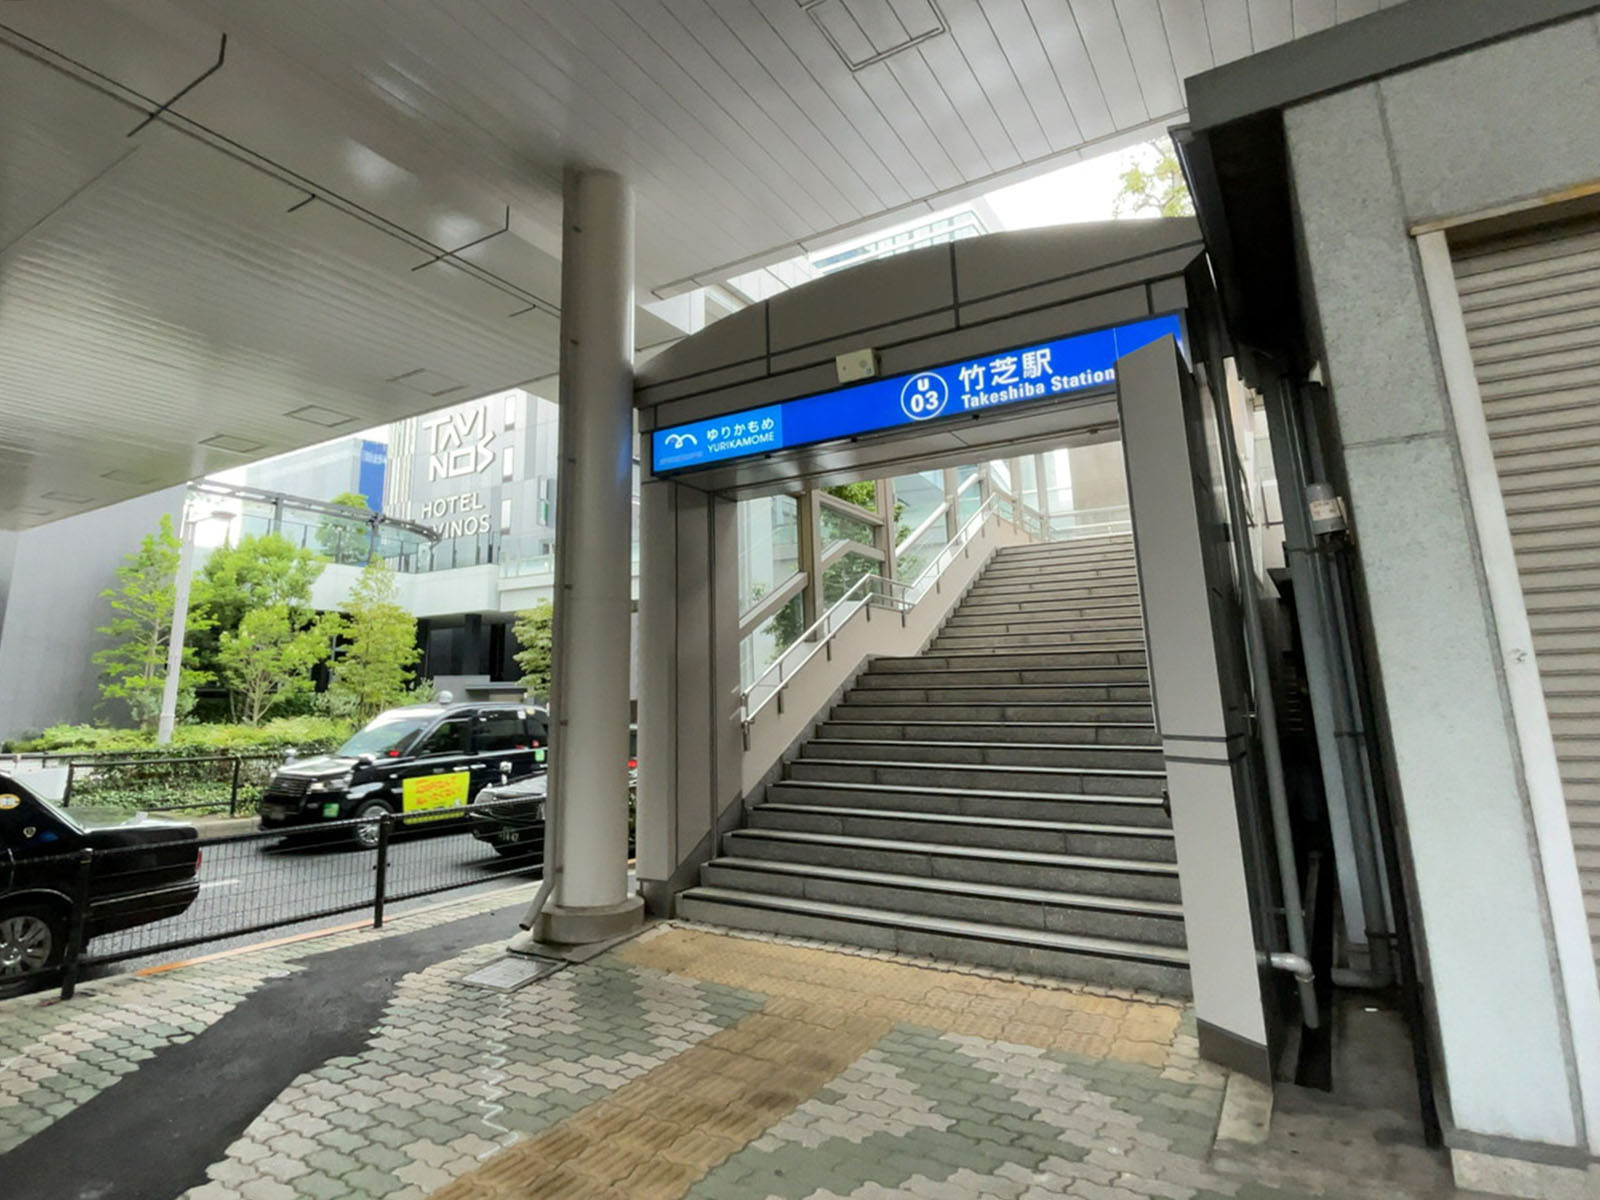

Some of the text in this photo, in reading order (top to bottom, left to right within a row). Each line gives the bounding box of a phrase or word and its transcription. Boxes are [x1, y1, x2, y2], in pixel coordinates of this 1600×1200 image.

[958, 348, 1053, 393] 竹芝駅
[917, 378, 930, 391] U
[961, 367, 1116, 409] Takeshiba Station
[910, 390, 939, 413] 03
[706, 417, 775, 441] ゆりかもめ
[707, 432, 775, 453] YURIKAMOME
[421, 492, 484, 519] HOTEL
[432, 514, 491, 539] VINOS
